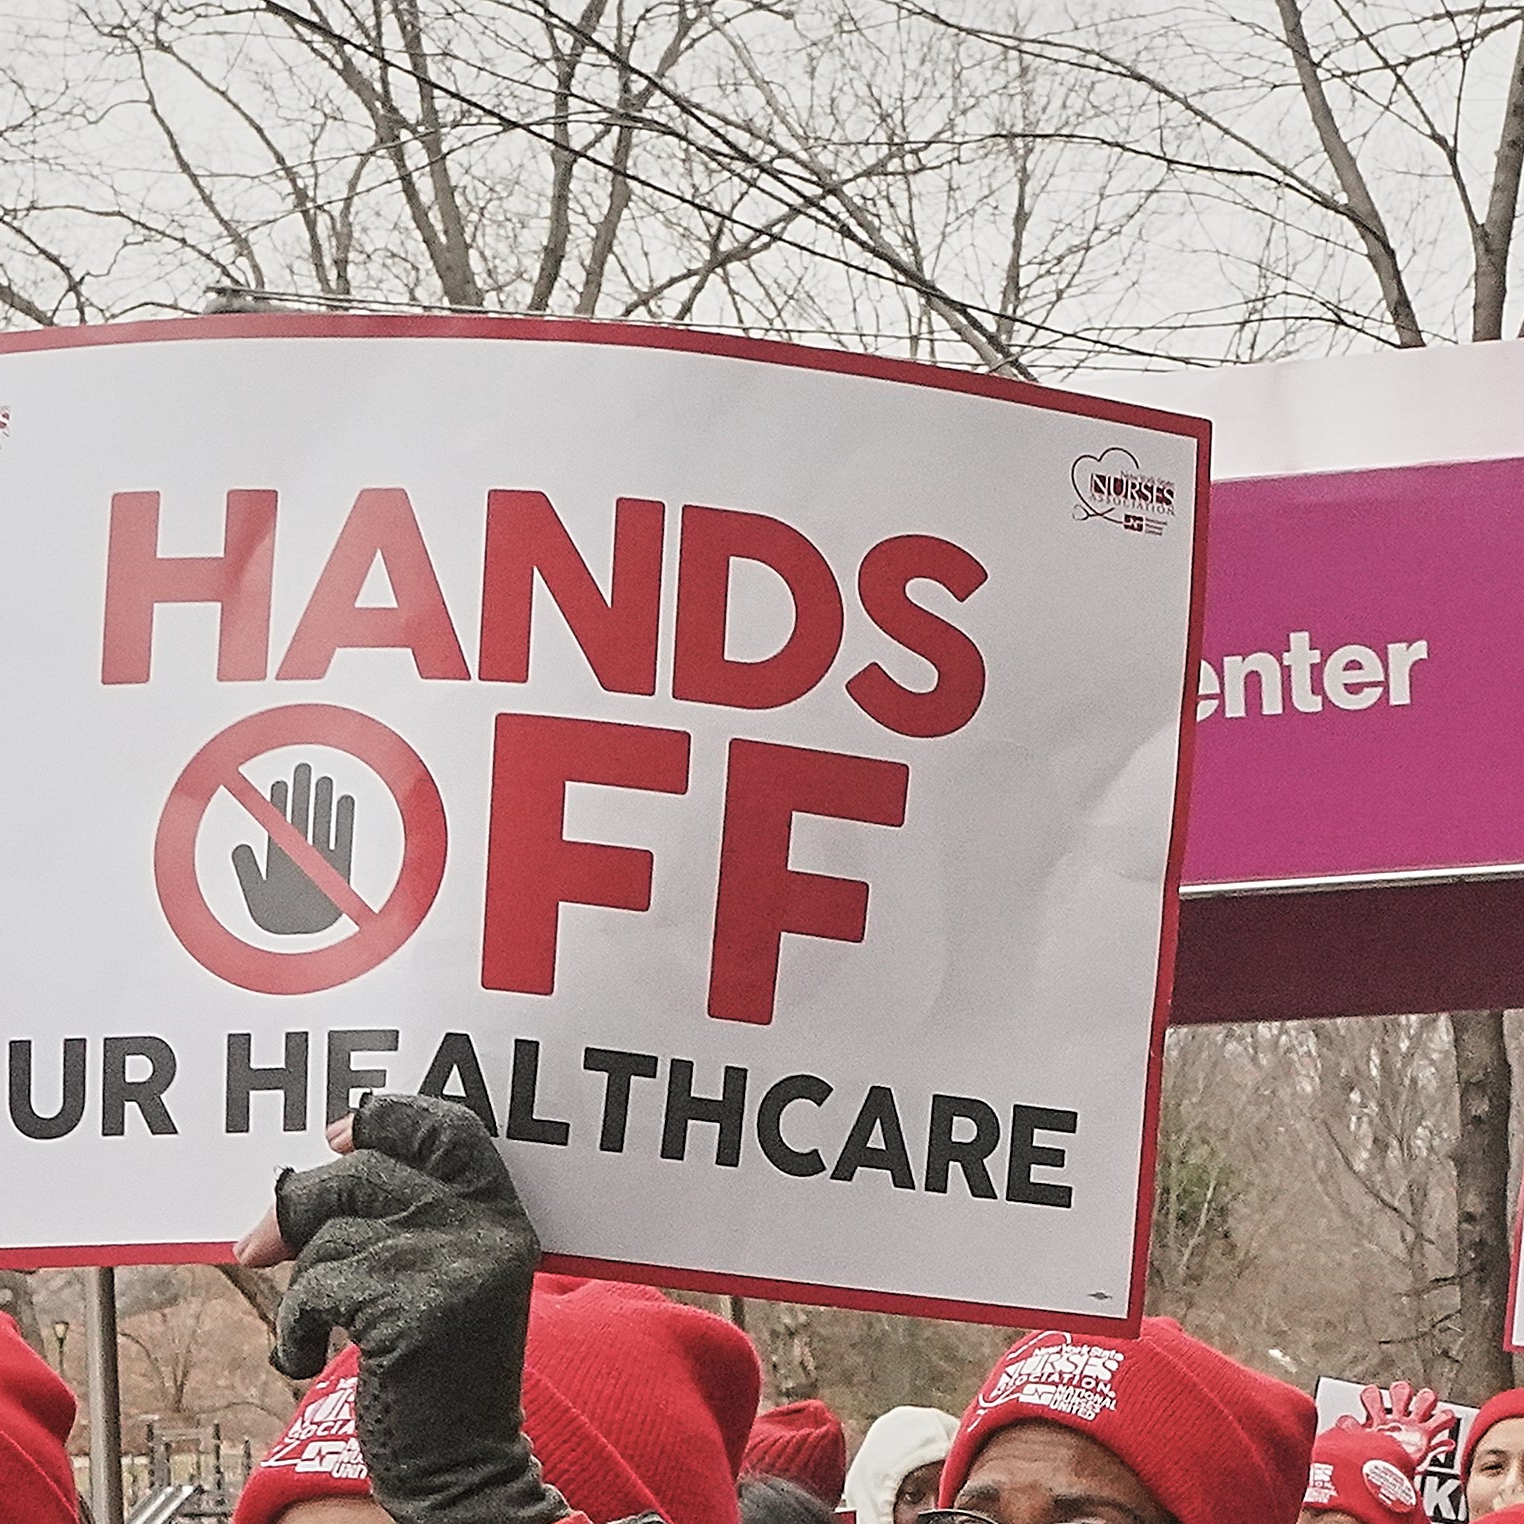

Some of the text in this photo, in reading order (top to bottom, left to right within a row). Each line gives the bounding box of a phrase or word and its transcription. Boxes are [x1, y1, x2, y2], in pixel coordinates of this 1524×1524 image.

[1091, 473, 1175, 507] NURSES
[1089, 494, 1176, 517] ASSOCIATION
[100, 488, 989, 739] HANDS
[223, 1028, 1077, 1209] HEALTHCARE
[1062, 1343, 1091, 1356] York
[1090, 1346, 1125, 1362] State
[1049, 1399, 1097, 1422] UNITED
[1056, 1384, 1117, 1412] NATIONAL
